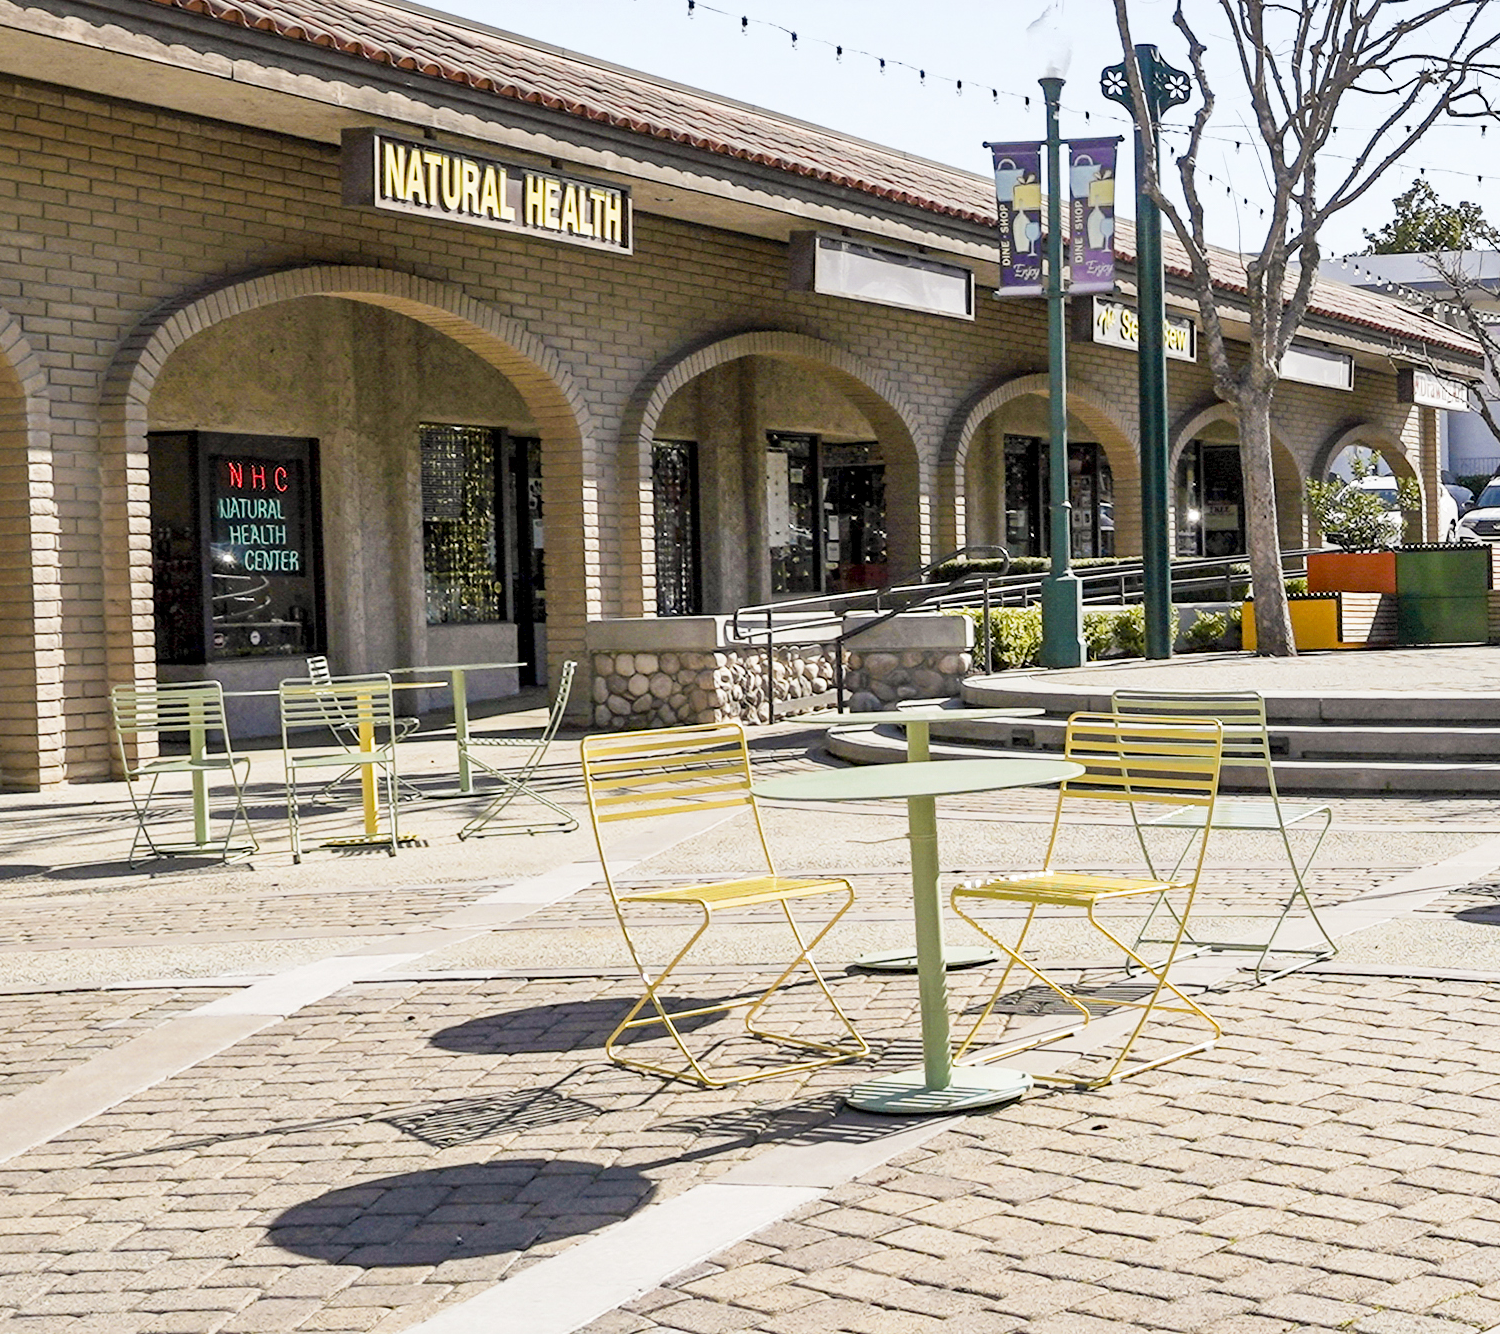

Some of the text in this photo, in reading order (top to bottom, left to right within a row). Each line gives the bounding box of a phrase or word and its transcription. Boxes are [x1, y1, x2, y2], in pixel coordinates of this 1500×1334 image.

[384, 142, 622, 243] NATURAL HEALTH
[999, 204, 1011, 267] DINE SHOP
[1074, 201, 1084, 264] DINE SHOP
[1013, 263, 1040, 281] Enjoy
[1086, 260, 1114, 277] Enjoy
[1120, 308, 1138, 342] Se
[219, 497, 285, 520] NATURAL
[229, 525, 287, 546] HEALTH
[244, 550, 300, 571] CENTER
